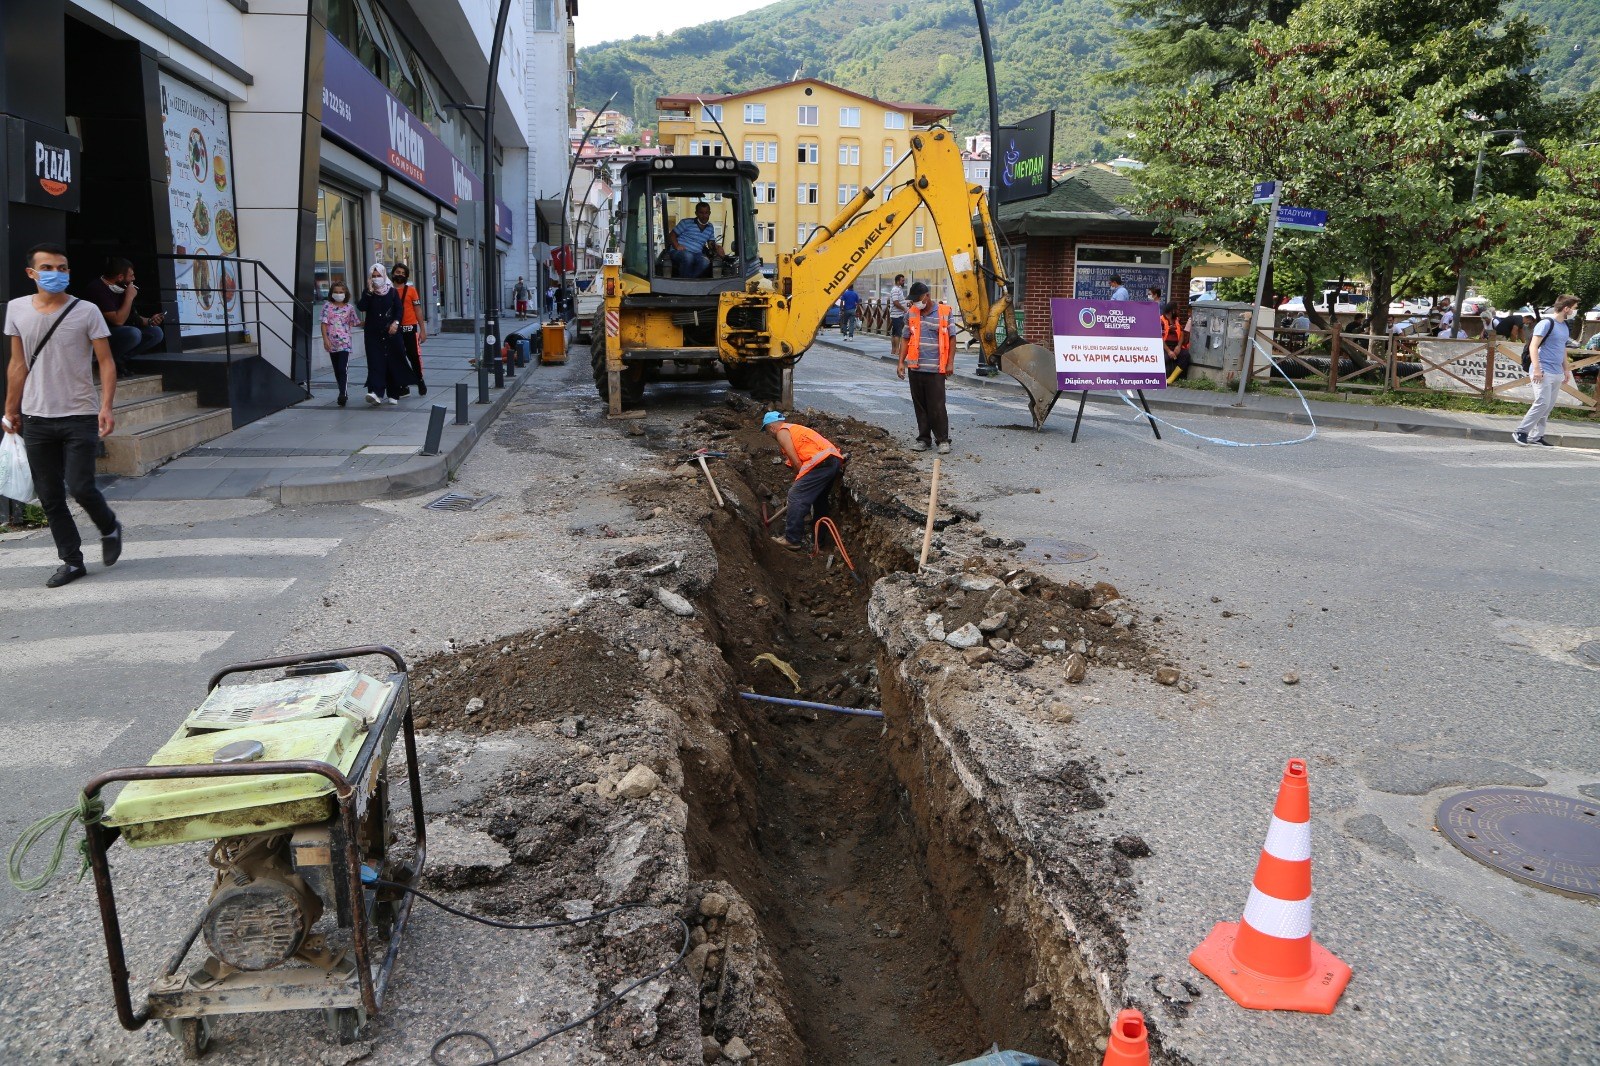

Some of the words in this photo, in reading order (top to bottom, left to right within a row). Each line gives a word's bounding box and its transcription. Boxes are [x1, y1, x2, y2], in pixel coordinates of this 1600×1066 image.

[329, 91, 339, 114] 222
[386, 94, 425, 171] Vatan
[36, 140, 71, 183] PLAZA
[392, 154, 423, 181] COMPUTER
[1014, 154, 1044, 179] MEYDAN
[452, 156, 472, 200] Vatan
[1280, 209, 1312, 218] STADYUM
[1083, 354, 1110, 362] YAPIM
[1113, 355, 1158, 364] ÇALIŞMASI
[1065, 378, 1094, 386] Düşünen,
[1097, 377, 1118, 385] Üreten,
